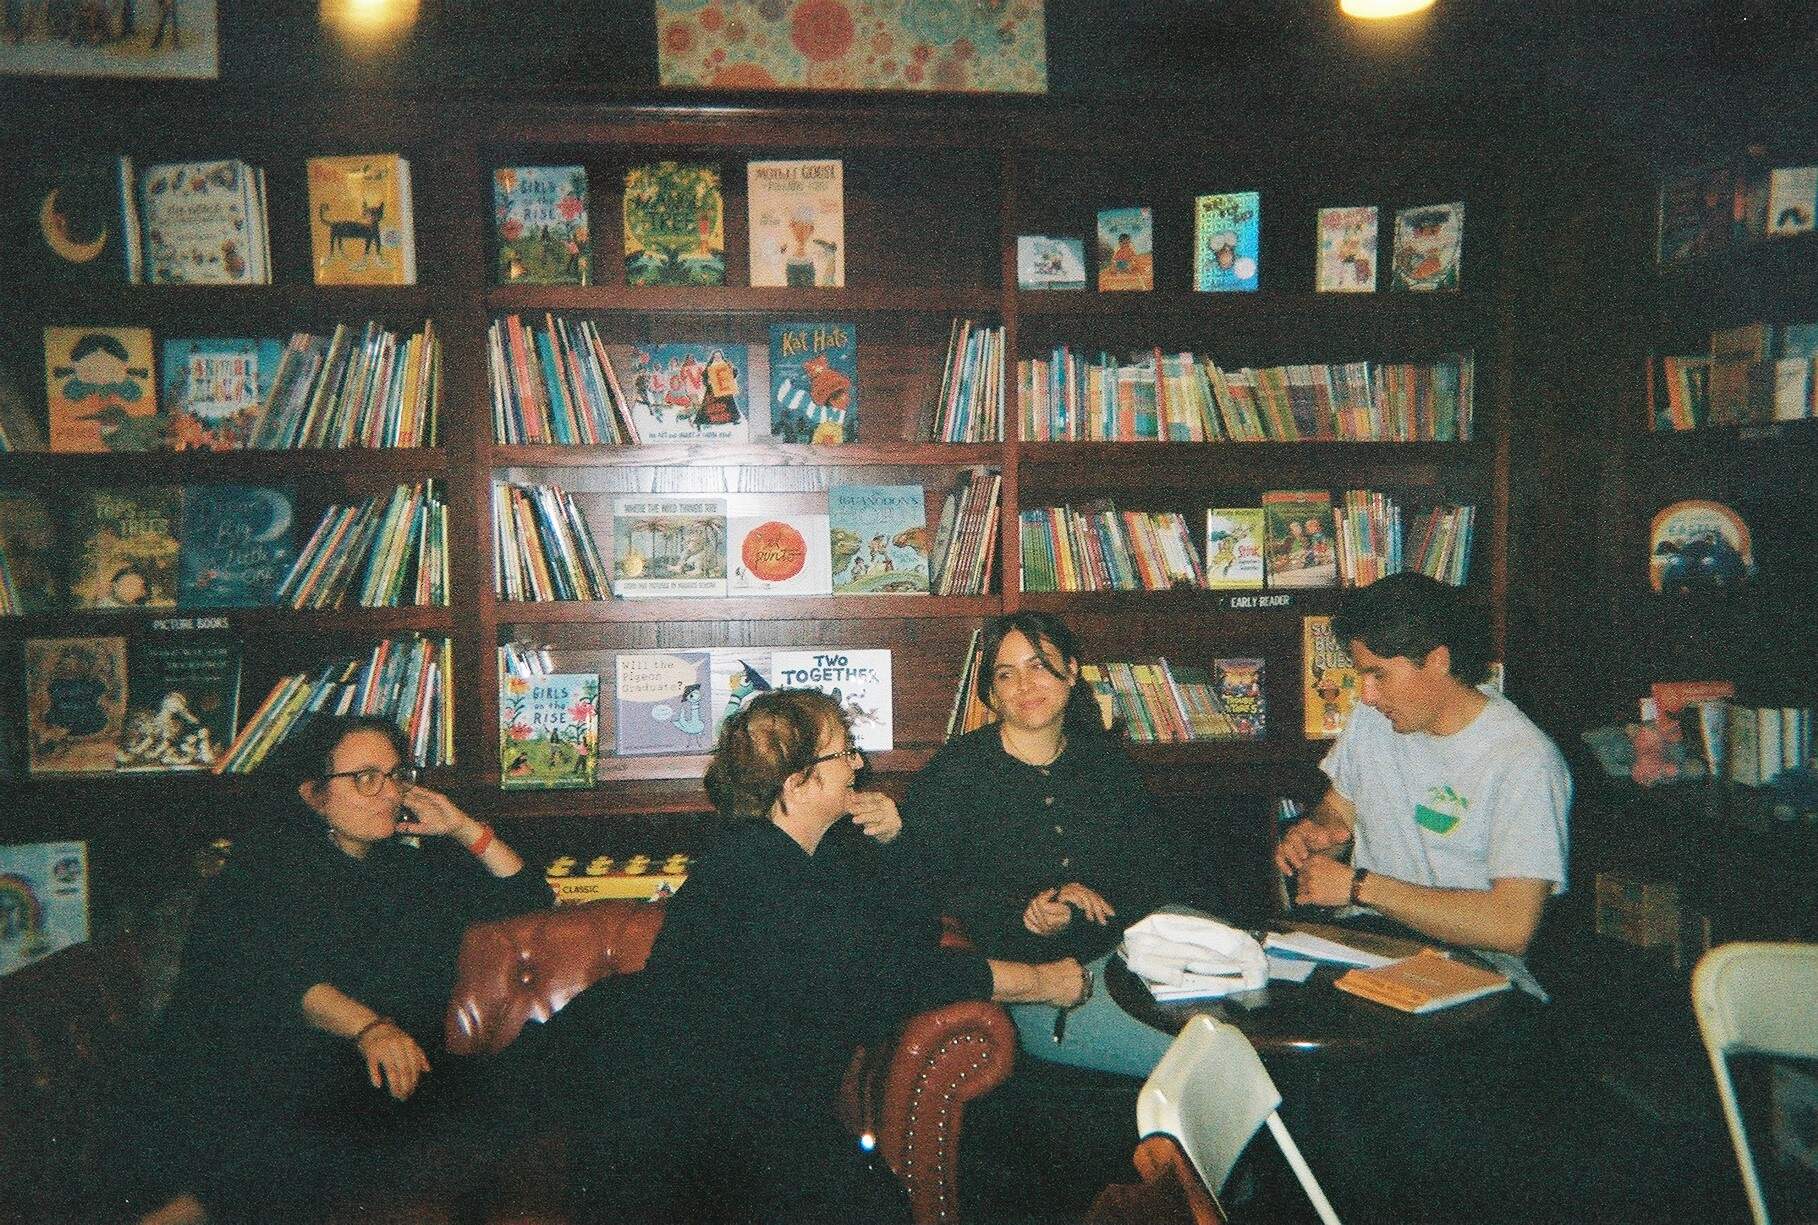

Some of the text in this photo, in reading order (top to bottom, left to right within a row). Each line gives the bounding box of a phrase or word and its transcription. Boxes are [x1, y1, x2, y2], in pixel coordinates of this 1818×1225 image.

[783, 326, 848, 357] Kat Hats
[1231, 594, 1290, 608] EARLY READER
[197, 617, 229, 629] BOOKS
[813, 655, 848, 667] TWO
[533, 687, 568, 699] GIRLS
[533, 712, 566, 724] RISE
[562, 885, 599, 894] CLASSIC
